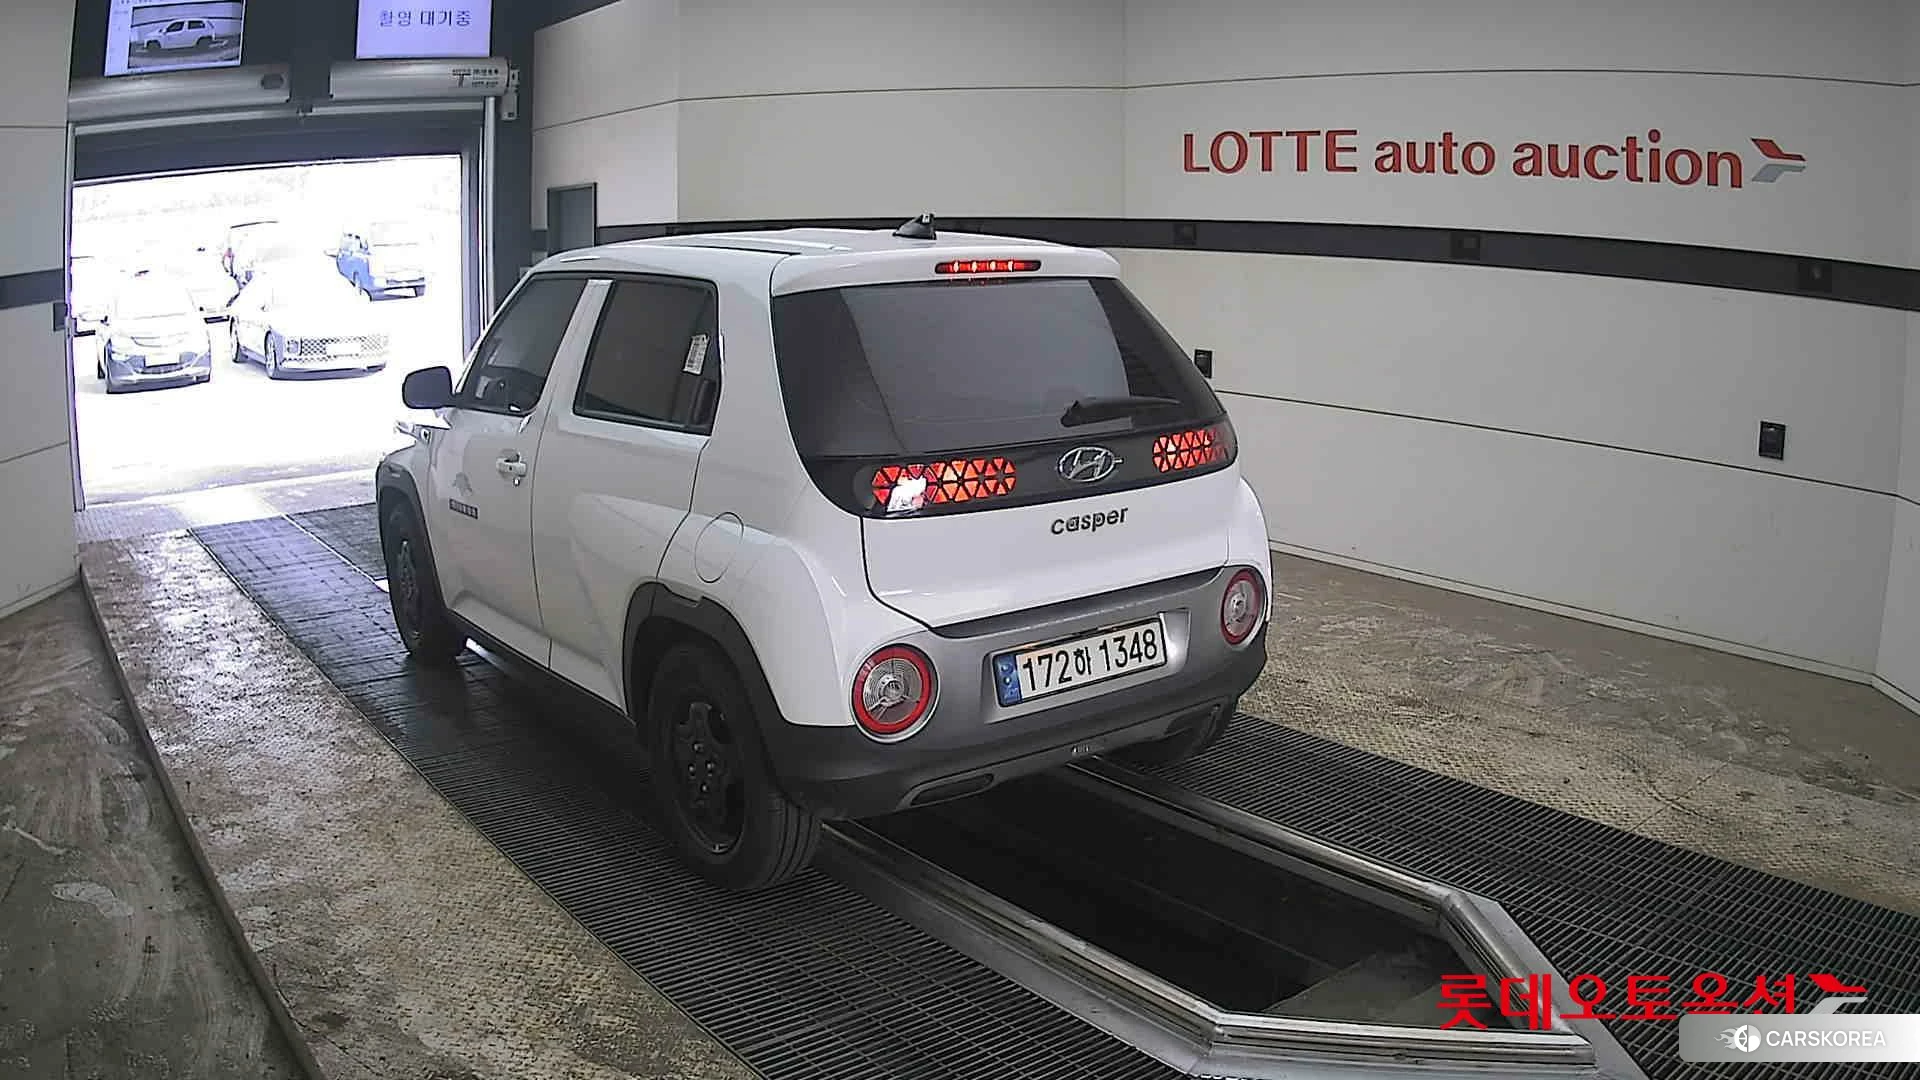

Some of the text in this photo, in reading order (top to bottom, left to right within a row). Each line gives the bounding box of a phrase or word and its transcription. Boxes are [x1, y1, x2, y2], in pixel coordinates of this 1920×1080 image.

[420, 9, 472, 27] 대기중
[1183, 129, 1743, 189] LOTTE auto auction
[1050, 507, 1129, 535] casper
[1022, 628, 1158, 692] 172하 1348
